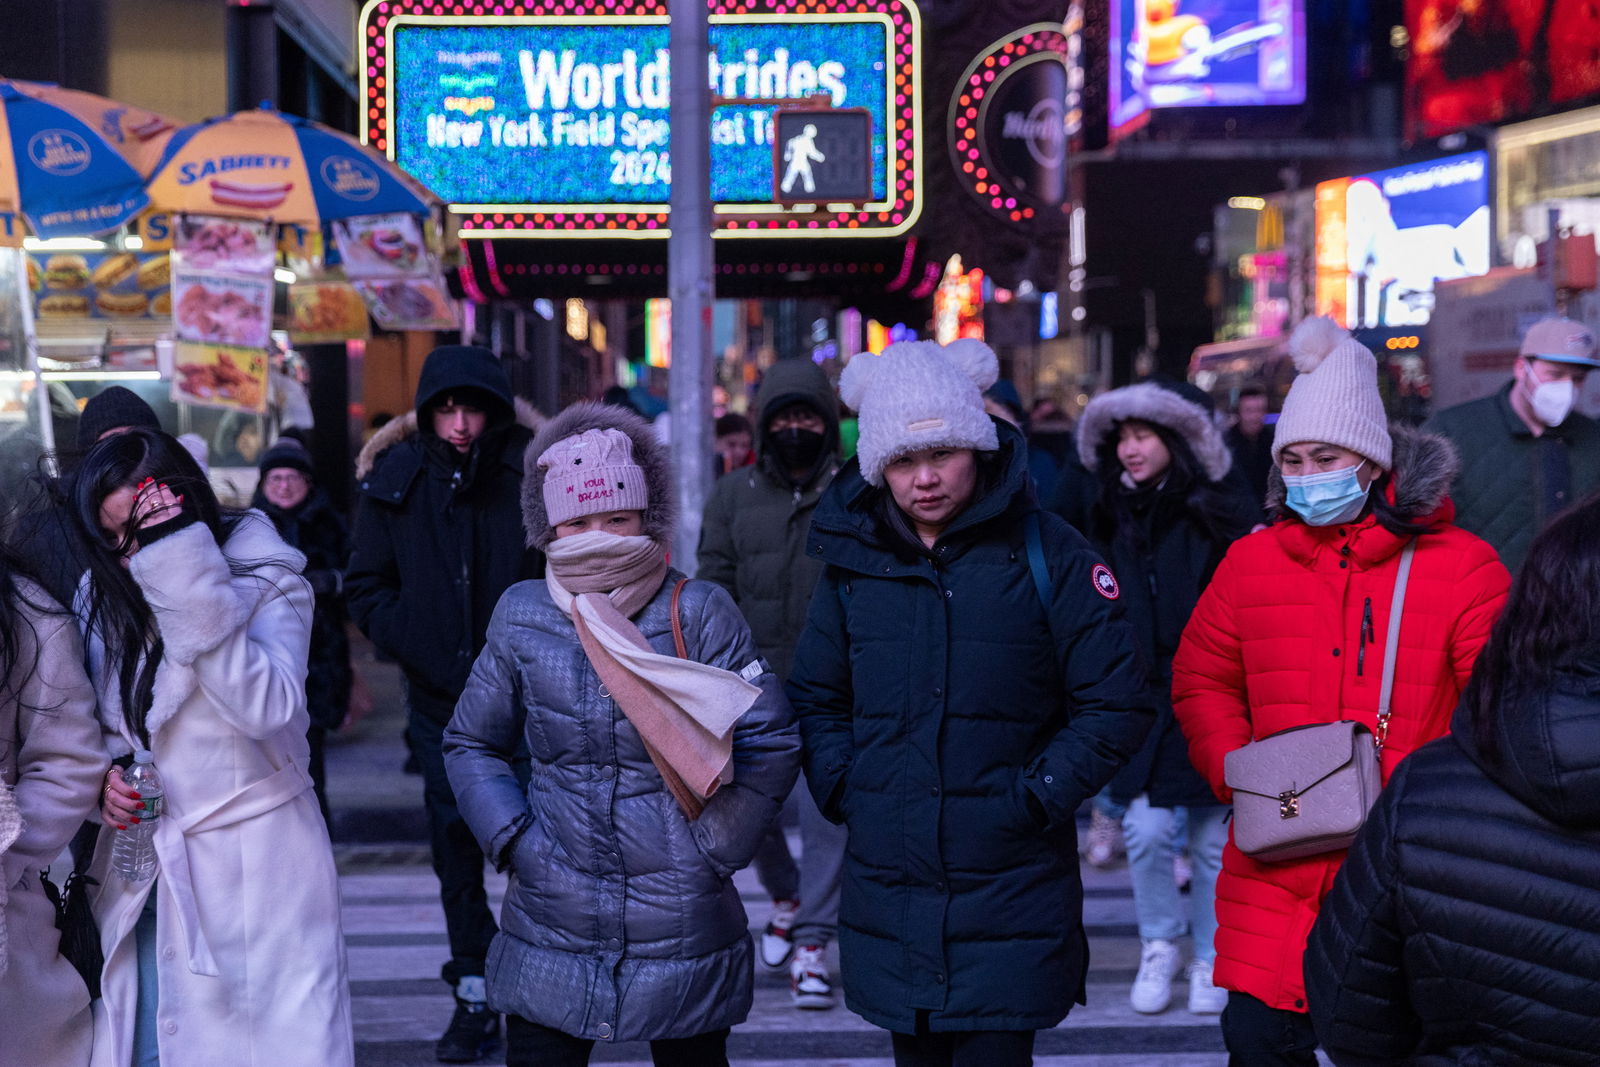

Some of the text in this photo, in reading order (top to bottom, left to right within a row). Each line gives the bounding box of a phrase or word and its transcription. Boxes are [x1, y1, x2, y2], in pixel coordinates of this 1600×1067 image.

[427, 112, 483, 148] New
[488, 112, 548, 147] York
[552, 111, 615, 147] Field
[609, 150, 671, 185] 2024
[584, 478, 605, 488] YOUR
[578, 489, 614, 502] DREAMS
